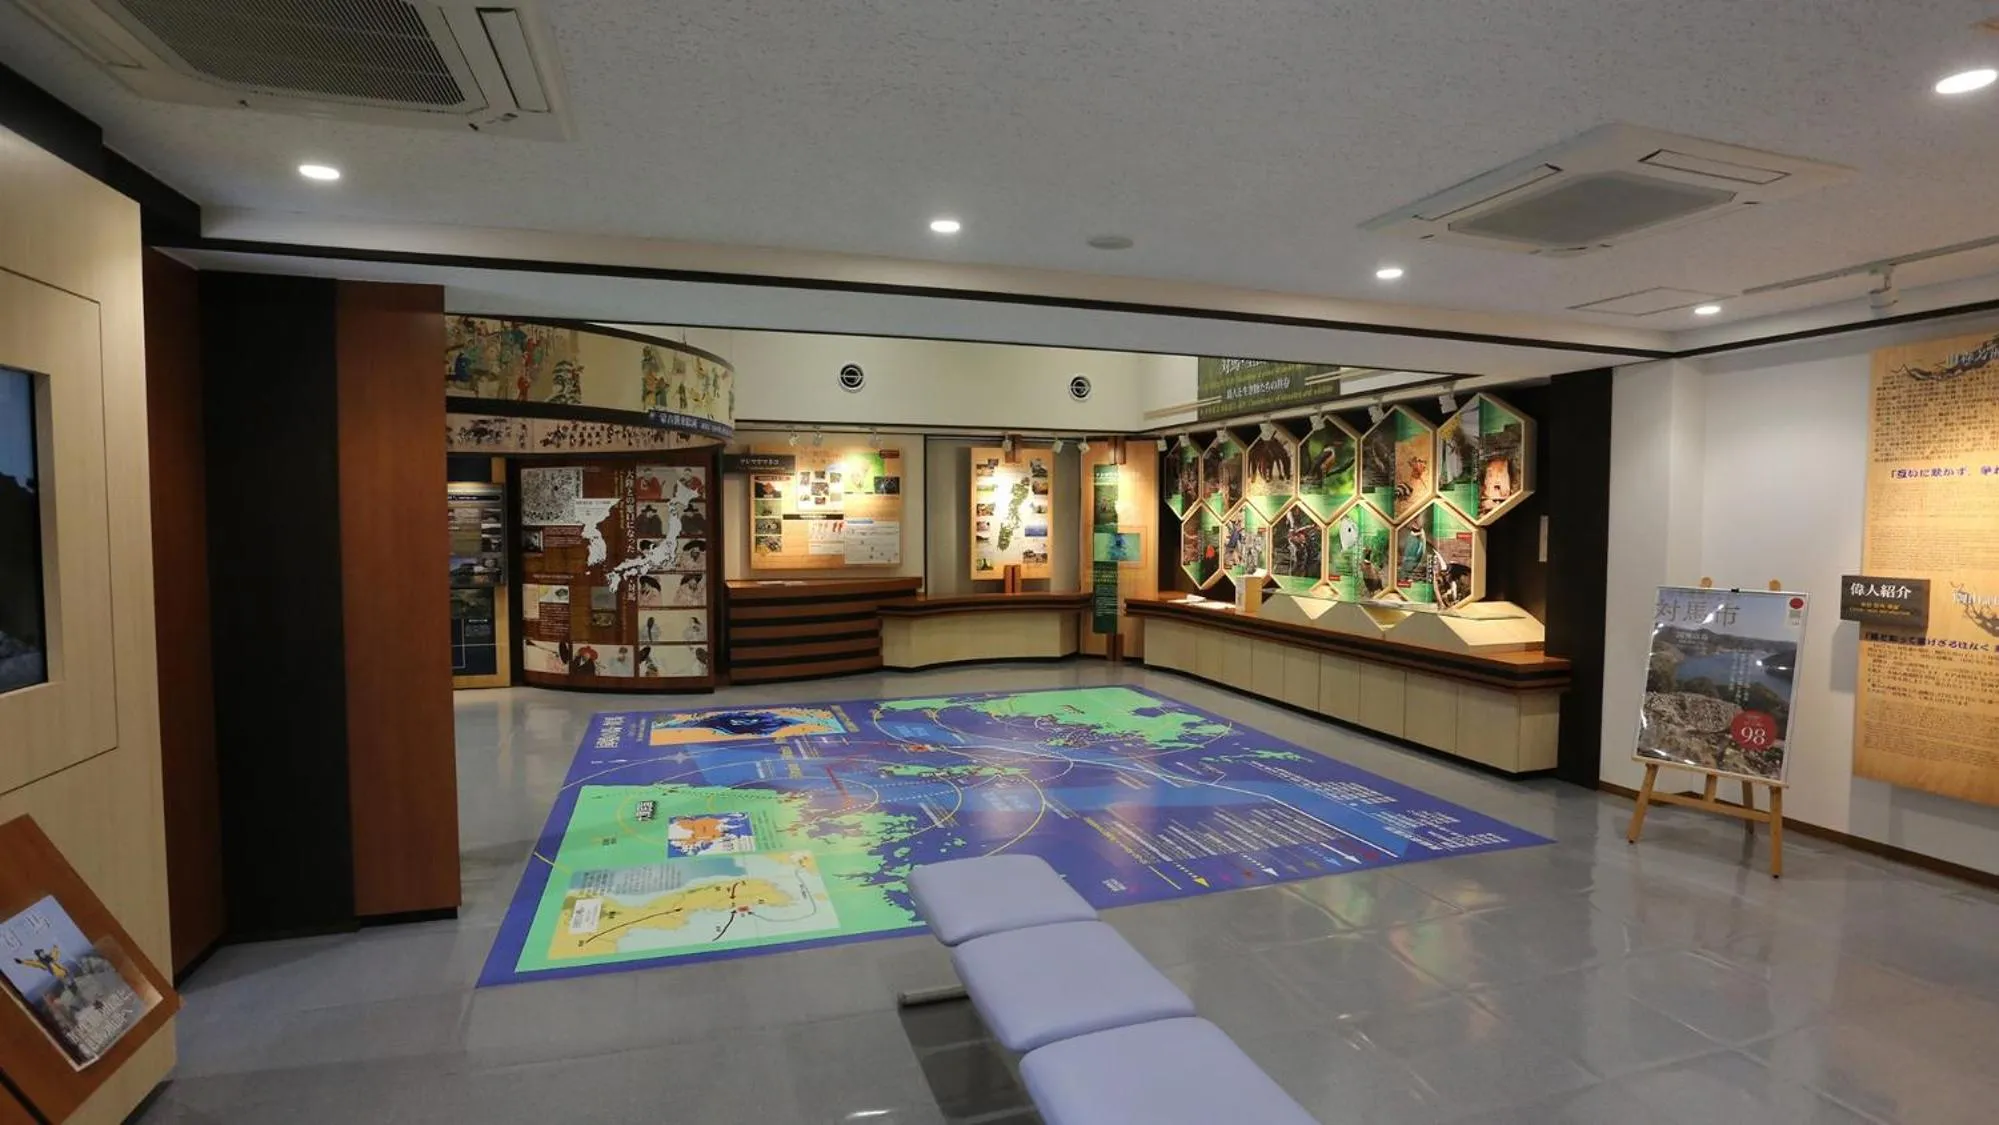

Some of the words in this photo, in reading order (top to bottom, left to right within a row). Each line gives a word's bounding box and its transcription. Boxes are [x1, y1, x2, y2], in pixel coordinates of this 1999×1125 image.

[1850, 582, 1912, 600] 偉人紹介
[1655, 599, 1742, 627] 対馬市
[1741, 726, 1766, 746] 98
